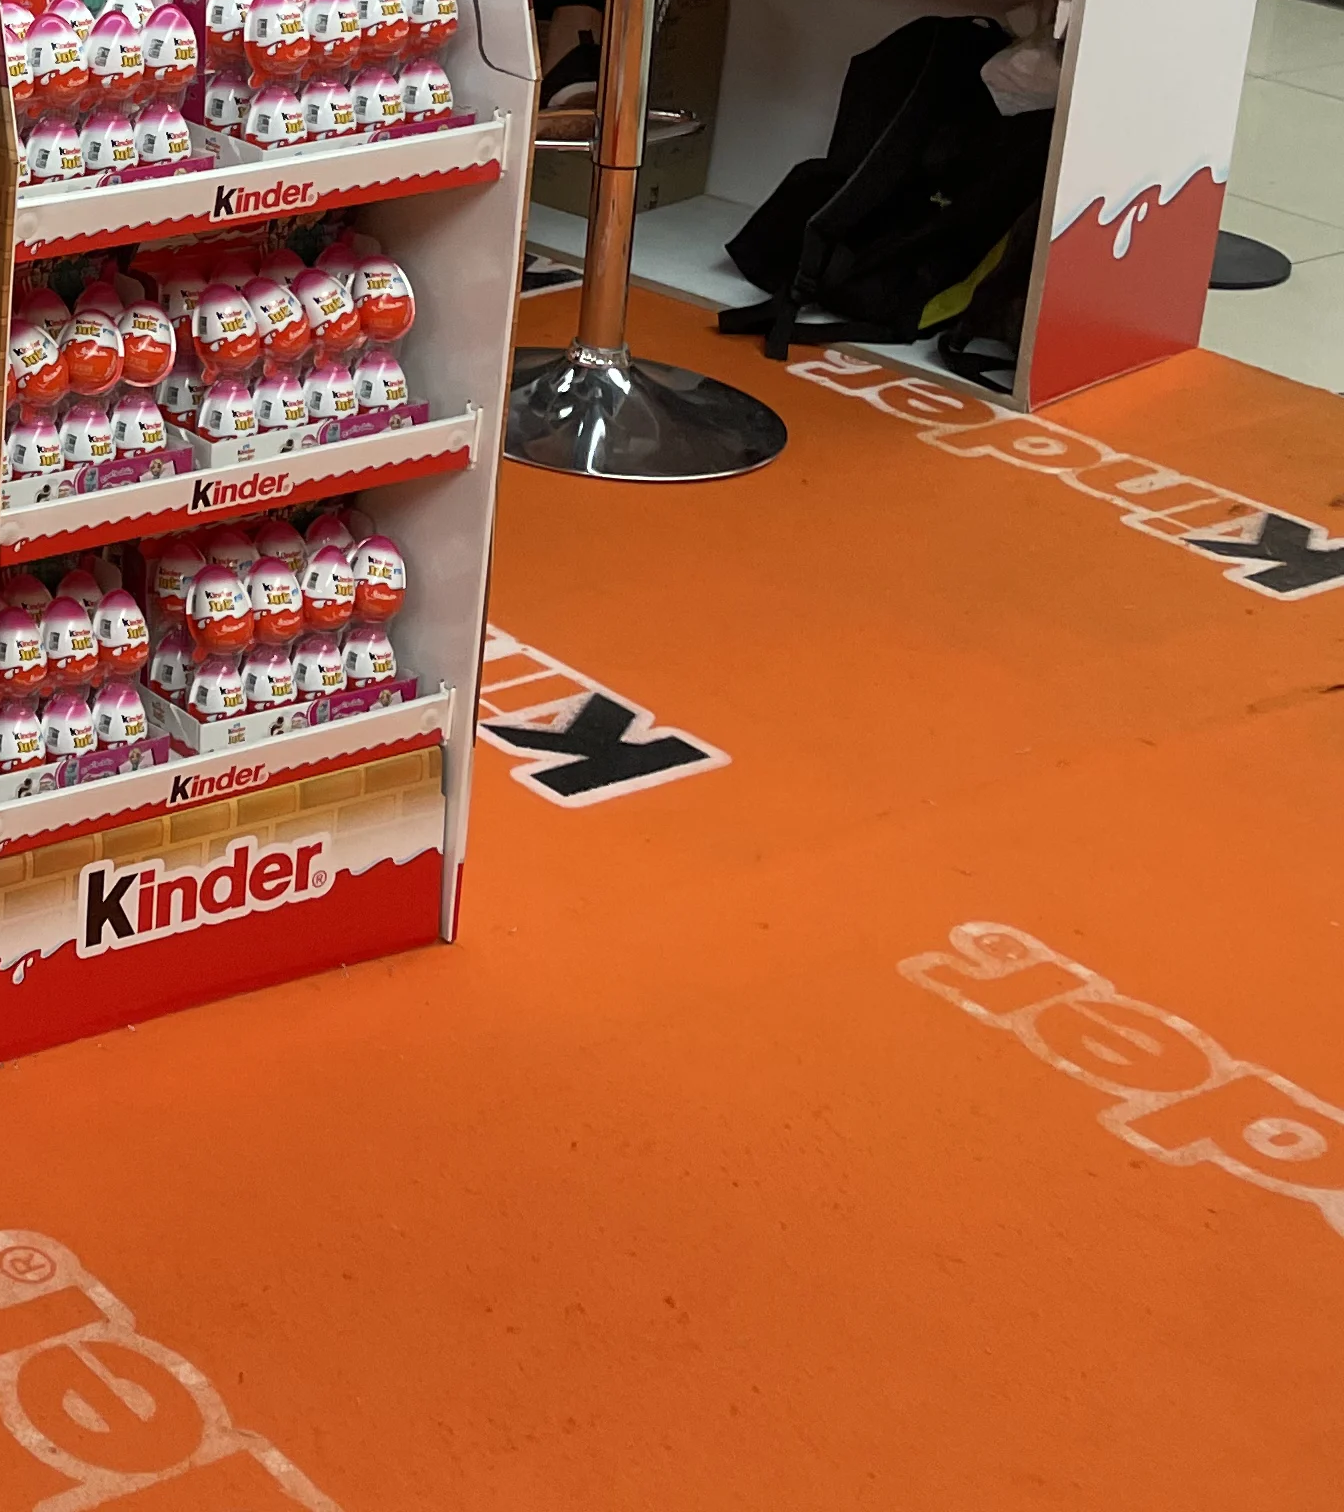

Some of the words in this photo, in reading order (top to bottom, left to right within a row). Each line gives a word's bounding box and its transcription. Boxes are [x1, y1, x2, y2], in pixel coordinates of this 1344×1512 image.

[214, 181, 313, 218] Kinder
[192, 473, 289, 509] Kinder
[170, 764, 266, 804] Kinder
[85, 841, 322, 948] Kinder
